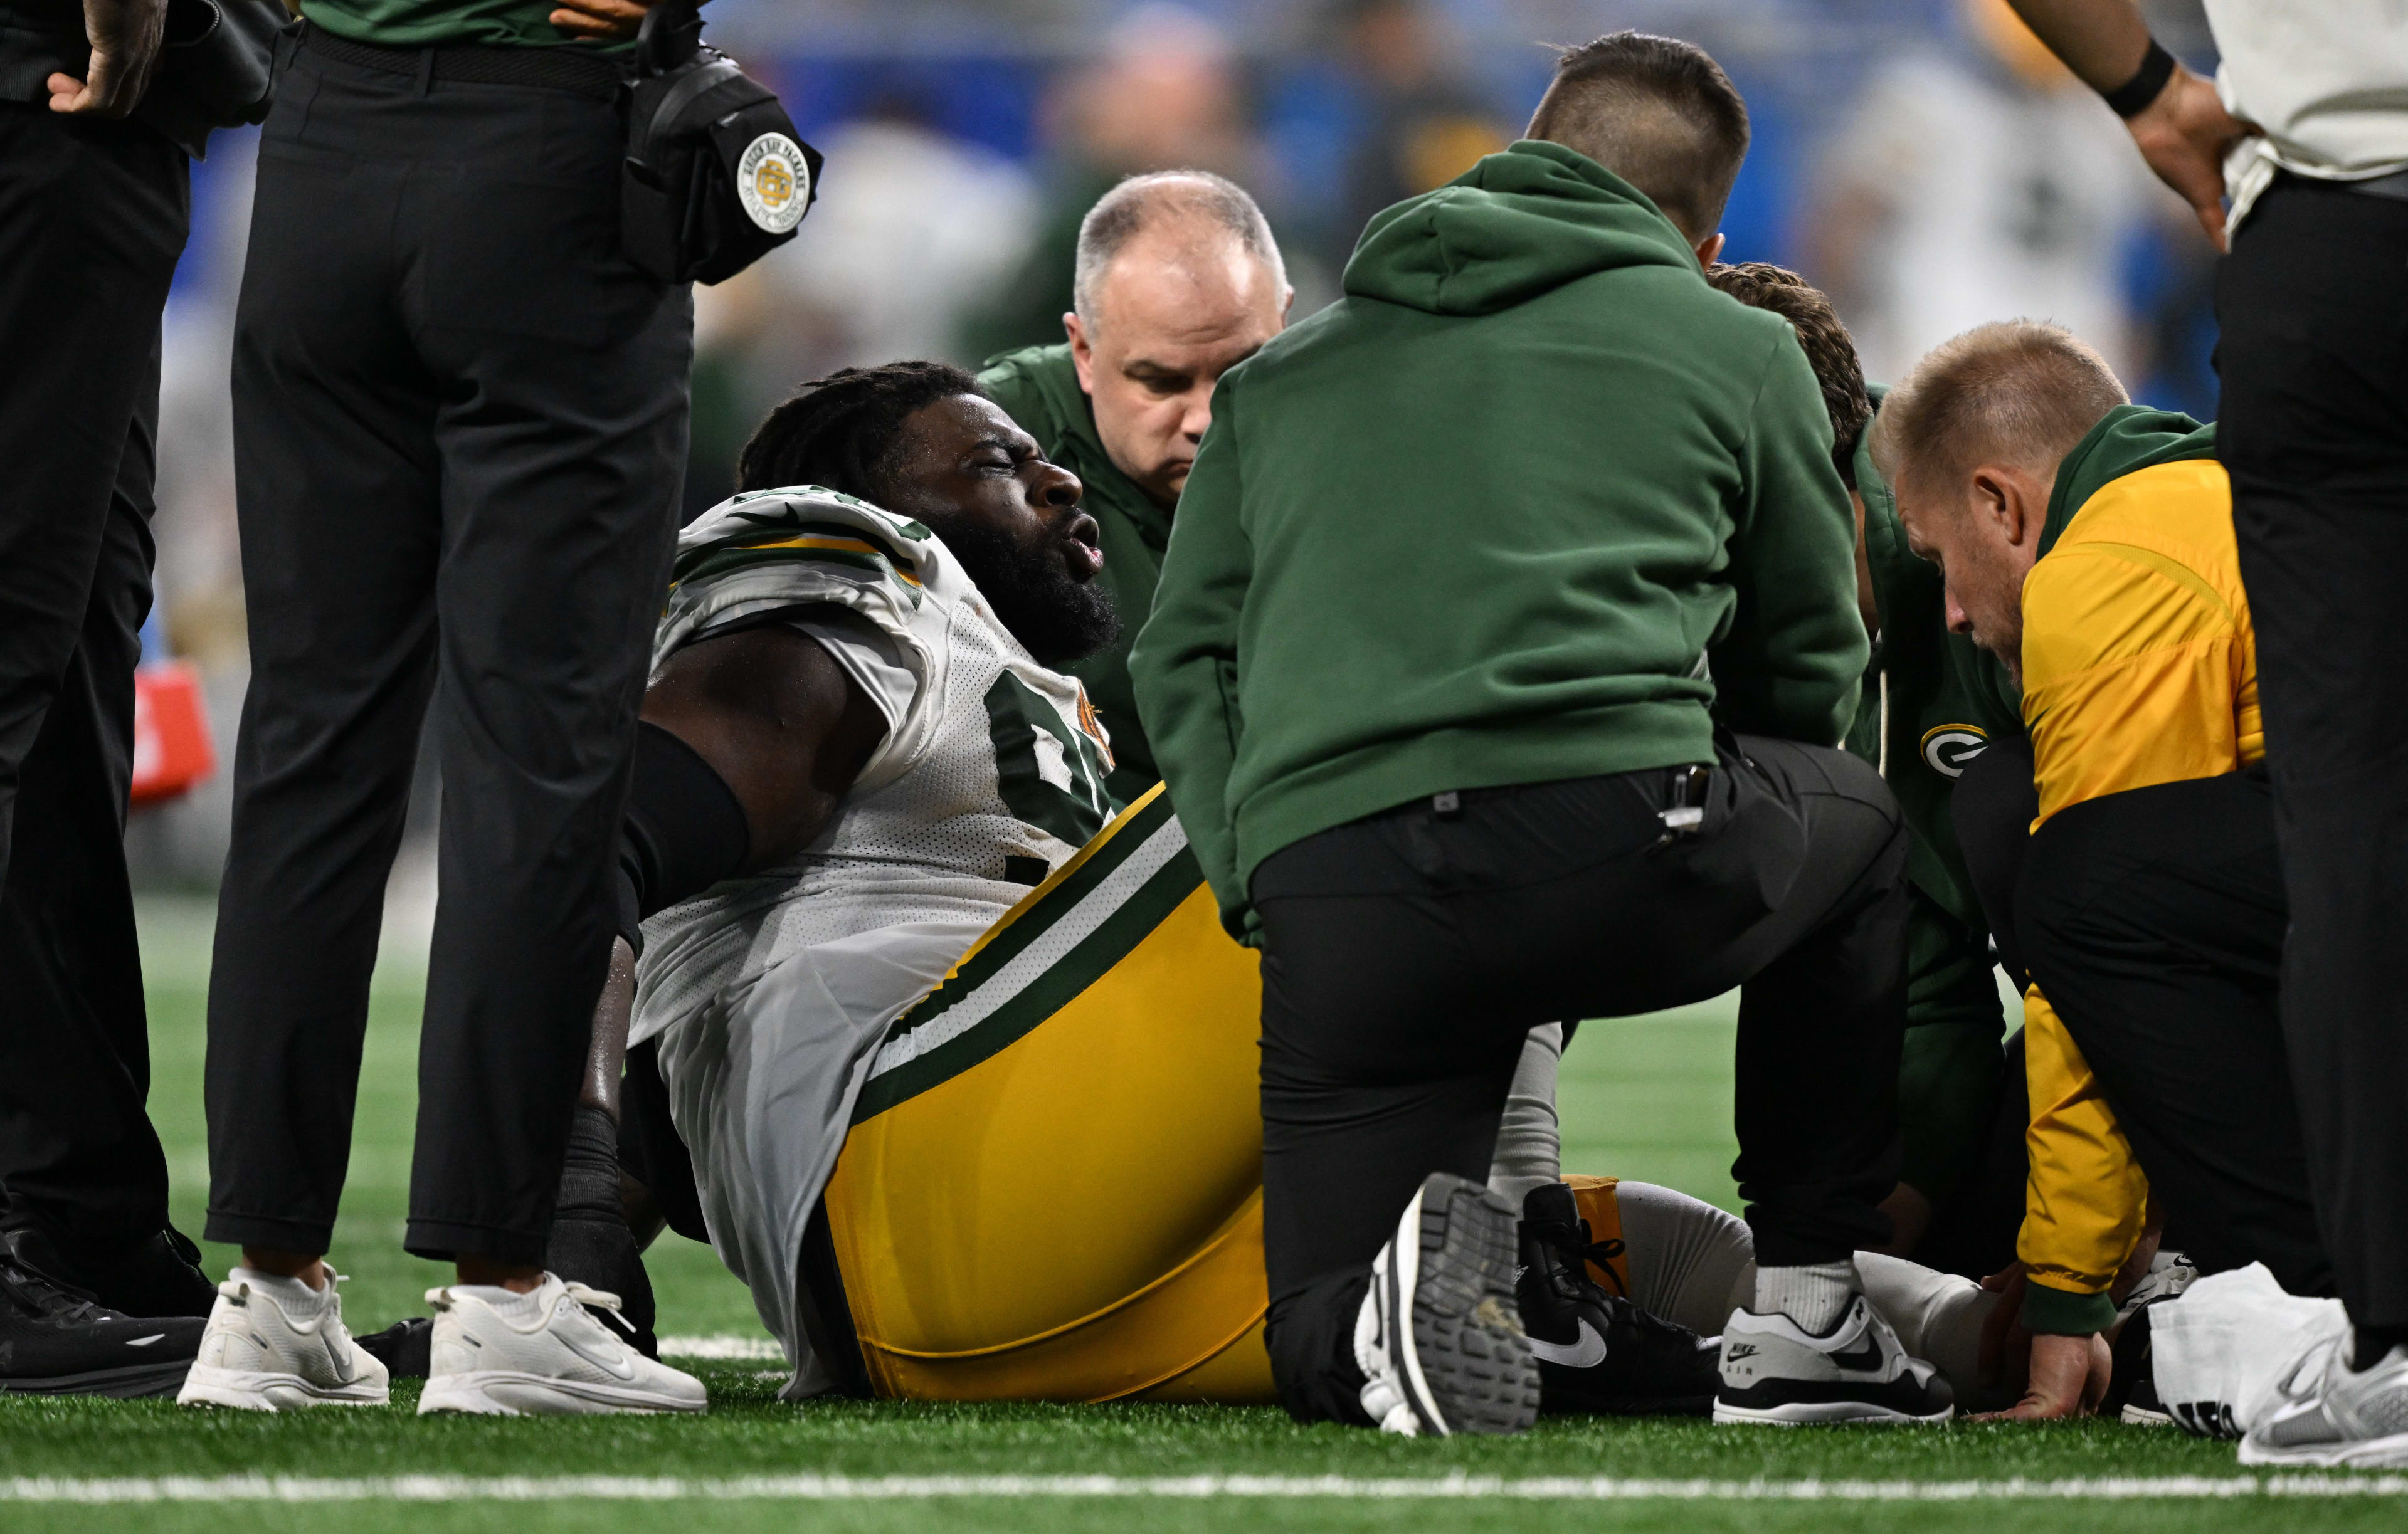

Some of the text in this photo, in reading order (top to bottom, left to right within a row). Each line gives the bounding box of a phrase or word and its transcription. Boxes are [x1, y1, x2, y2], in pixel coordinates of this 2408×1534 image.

[1926, 733, 1989, 778] G
[1730, 1343, 1756, 1355] NIKE
[1726, 1365, 1753, 1376] AIR
